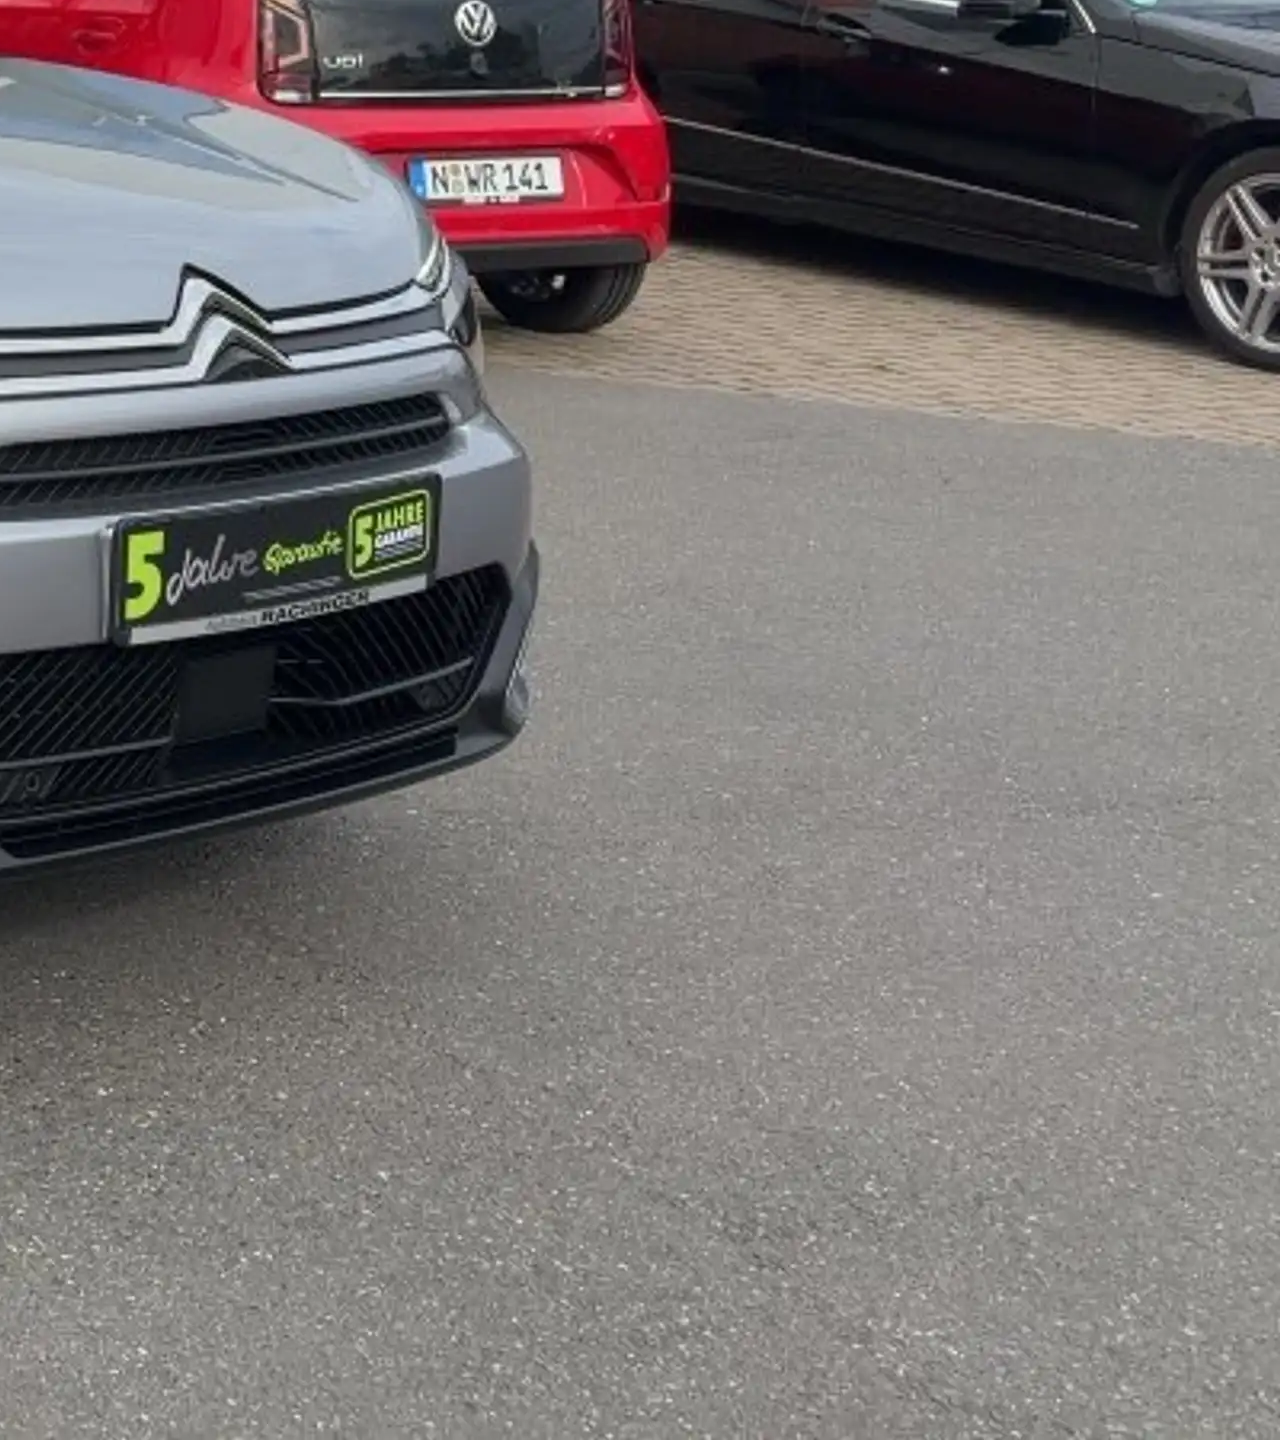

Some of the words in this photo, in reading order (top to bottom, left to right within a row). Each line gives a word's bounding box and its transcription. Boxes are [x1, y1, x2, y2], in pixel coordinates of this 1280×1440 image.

[431, 165, 449, 194] N
[464, 163, 499, 193] WR
[503, 162, 549, 192] 141
[353, 514, 374, 568] 5
[375, 499, 425, 533] JAHRE
[124, 529, 166, 620] 5
[166, 533, 260, 606] Jahre
[262, 529, 344, 576] Garantie
